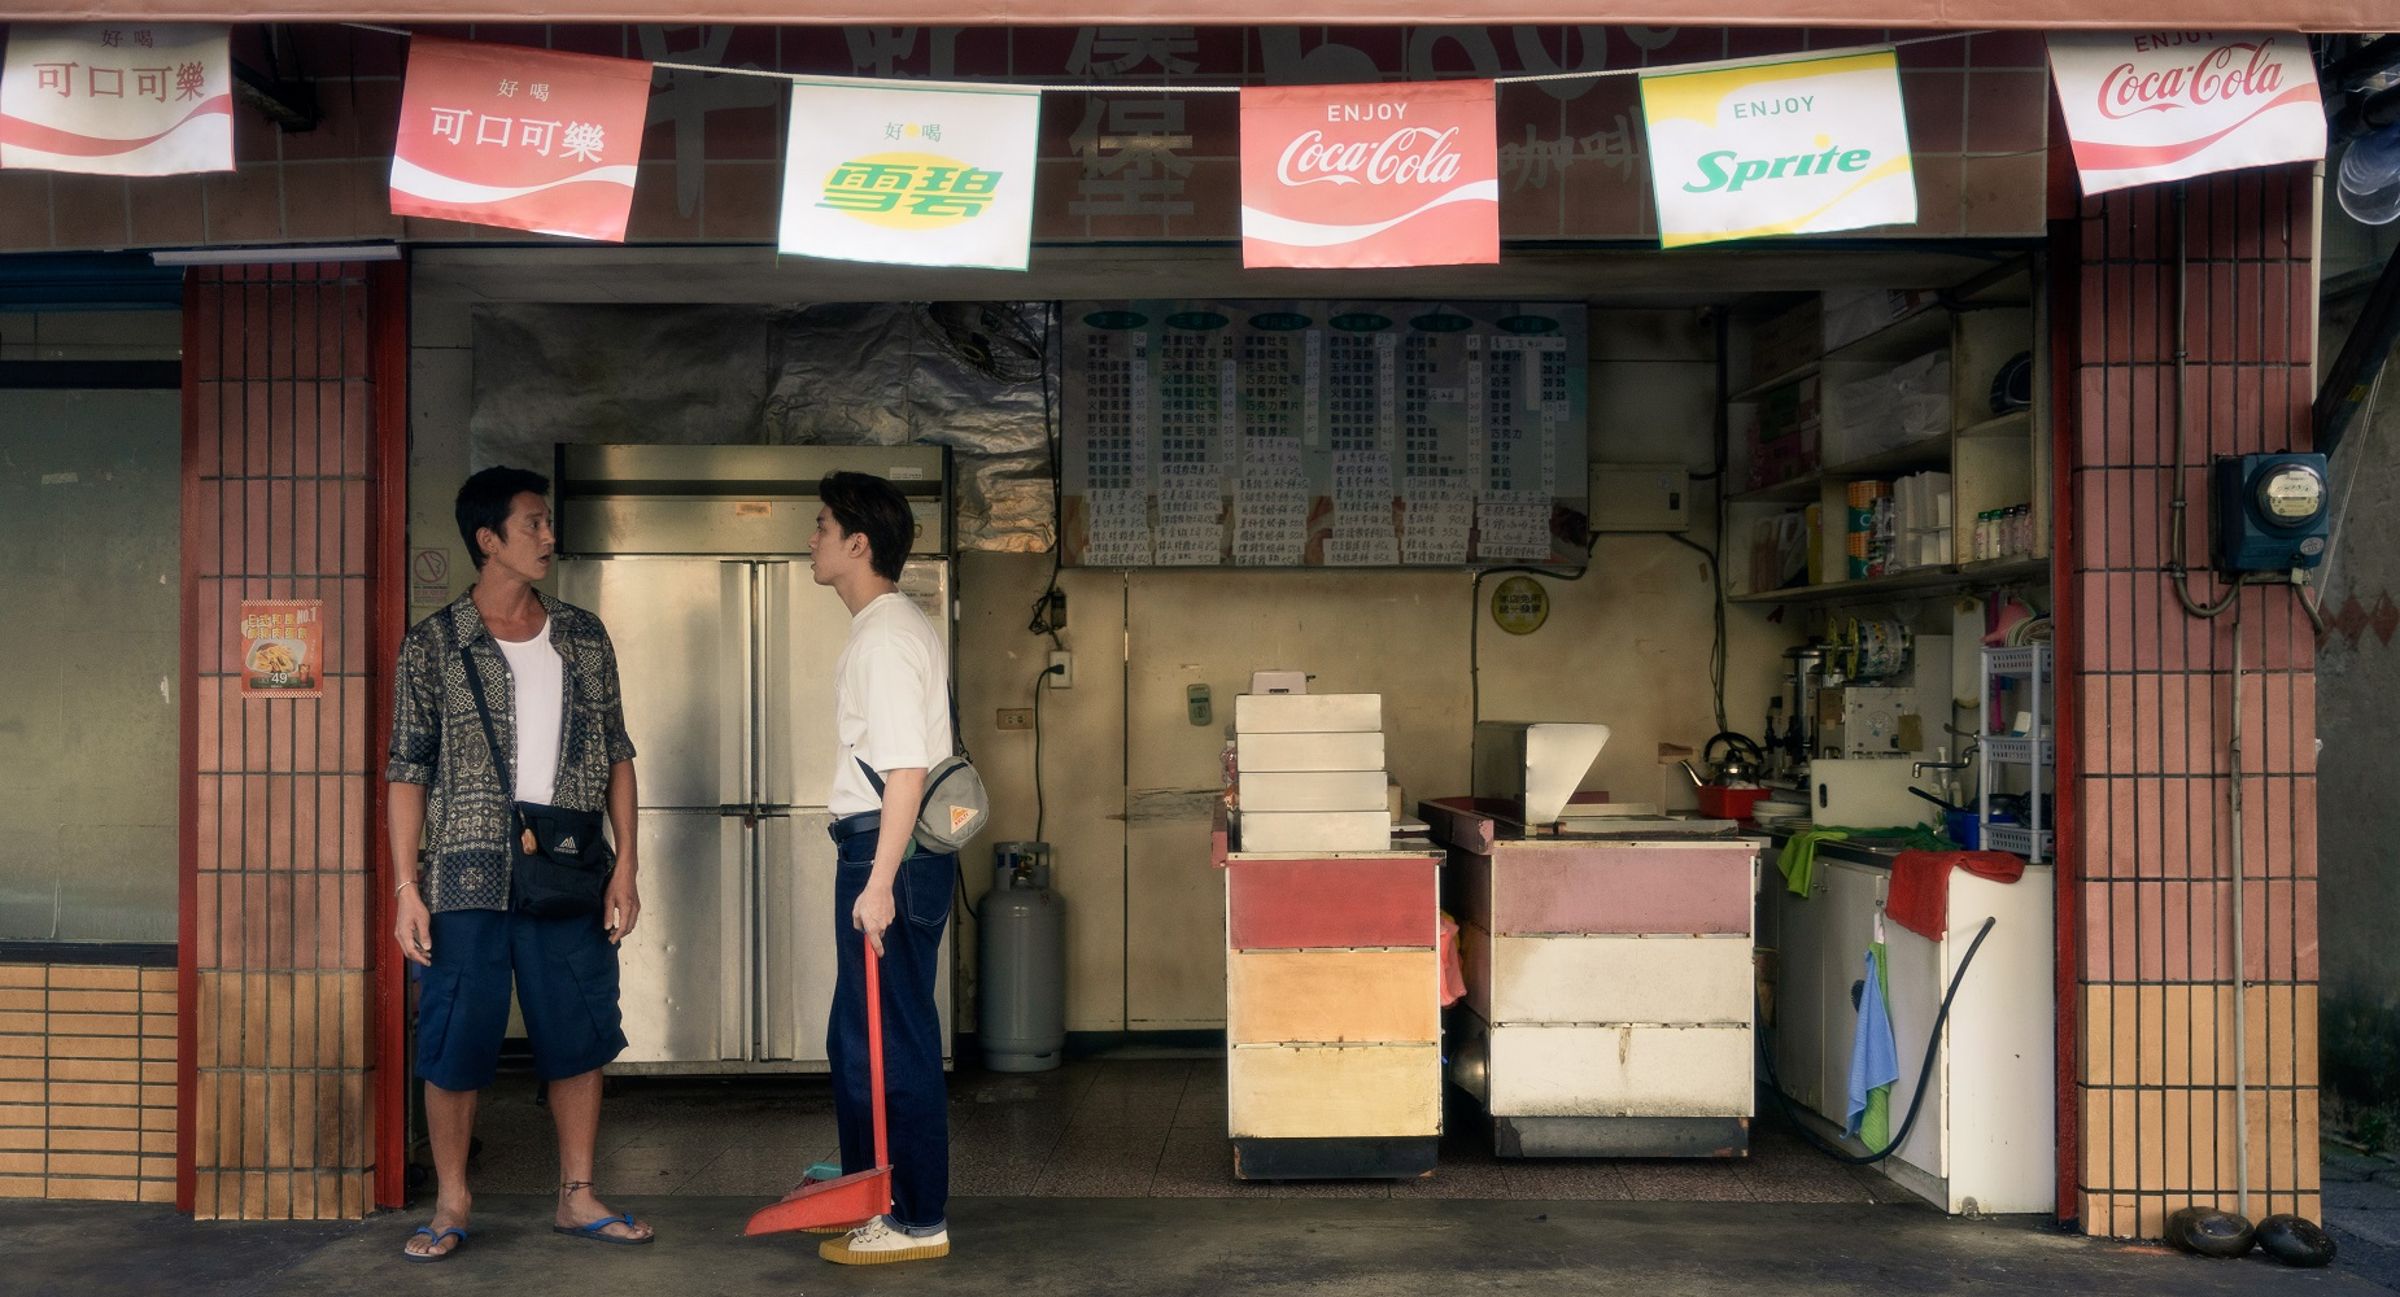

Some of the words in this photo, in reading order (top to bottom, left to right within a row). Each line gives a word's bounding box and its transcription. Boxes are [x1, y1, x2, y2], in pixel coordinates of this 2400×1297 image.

[101, 28, 155, 49] 好喝
[32, 60, 206, 103] 可口可樂
[496, 77, 550, 103] 好喝
[2097, 36, 2284, 120] Coca-Cola
[1327, 103, 1408, 123] ENJOY
[1733, 95, 1815, 120] ENJOY
[429, 106, 605, 164] 可口可樂
[884, 121, 942, 143] 好喝
[1276, 125, 1462, 187] Coca-Cola
[1682, 133, 1872, 196] Sprite
[814, 161, 1004, 218] 雪碧
[270, 672, 288, 684] 49
